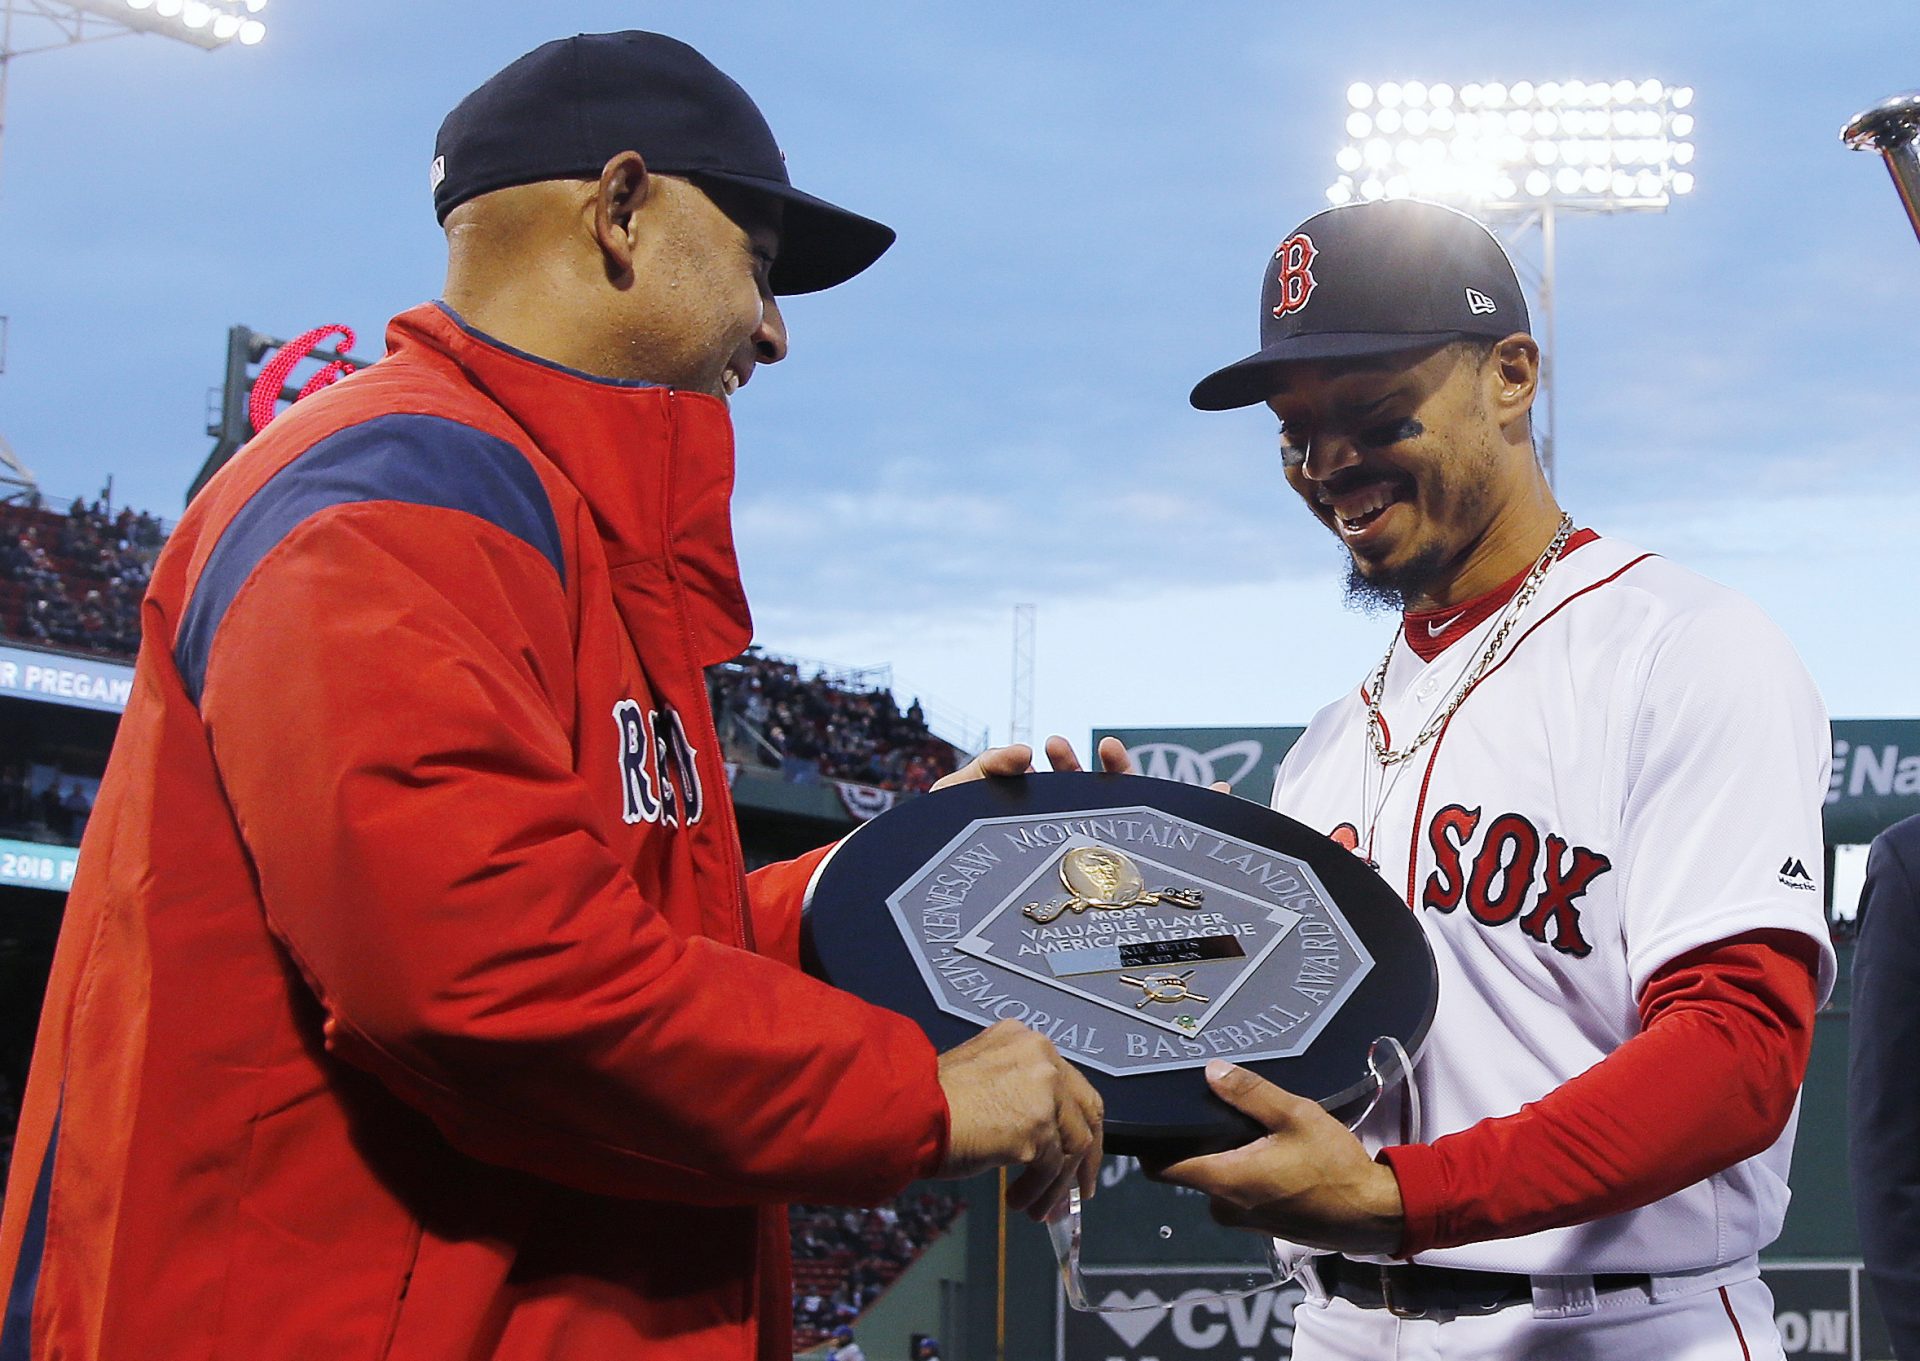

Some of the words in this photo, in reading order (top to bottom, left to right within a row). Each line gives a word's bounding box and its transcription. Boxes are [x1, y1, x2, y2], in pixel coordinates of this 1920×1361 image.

[1272, 232, 1320, 319] B
[923, 843, 1002, 943] KENESAW
[1004, 818, 1200, 854] MOUNTAIN
[1207, 840, 1321, 915] LANDIS
[1089, 907, 1146, 922] MOST
[1424, 803, 1611, 959] SOX
[1018, 932, 1154, 957] AMERICAN
[1155, 923, 1257, 944] LEAGUE
[1022, 920, 1141, 941] VALUABLE
[1147, 912, 1232, 930] PLAYER
[932, 954, 1105, 1054] MEMORIAL
[1126, 1004, 1311, 1058] BASEBALL
[1291, 920, 1341, 1007] AWARD
